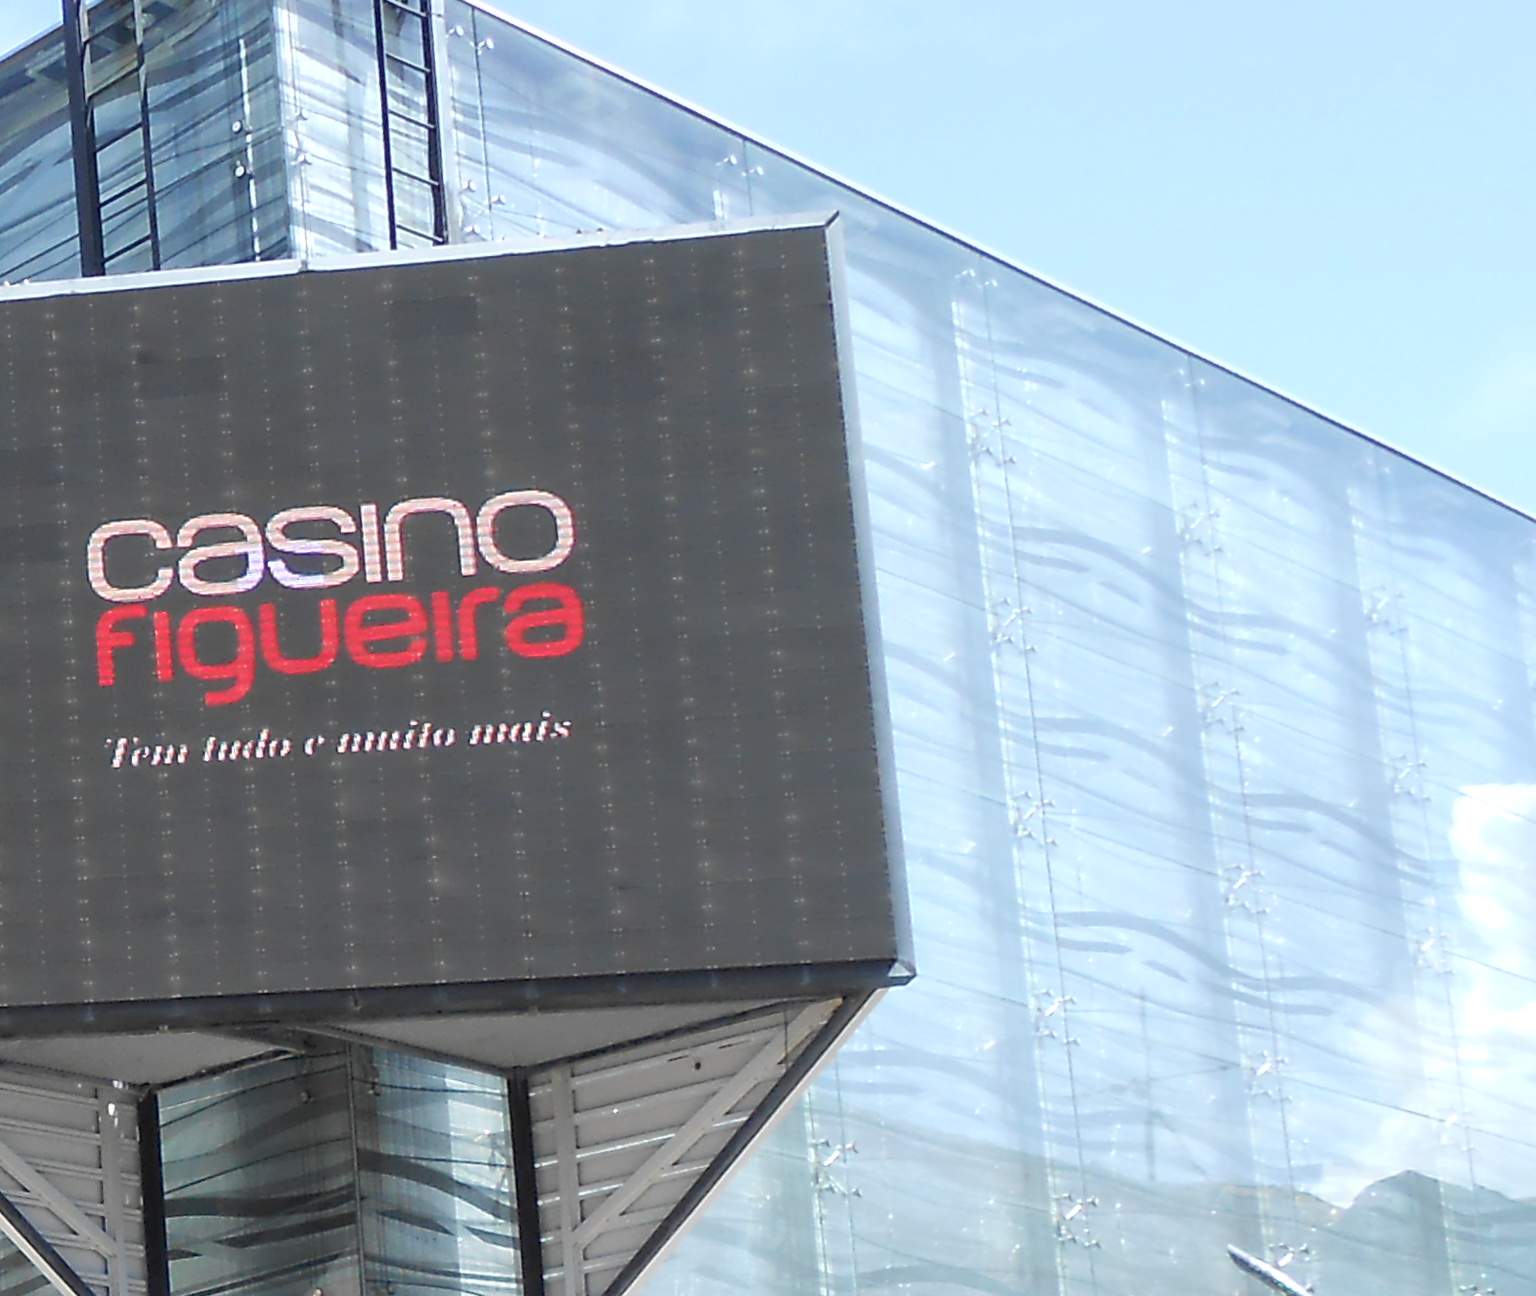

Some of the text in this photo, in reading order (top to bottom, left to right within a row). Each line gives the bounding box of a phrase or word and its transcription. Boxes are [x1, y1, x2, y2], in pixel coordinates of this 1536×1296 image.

[86, 488, 575, 604] casino
[94, 581, 586, 706] figueira
[106, 710, 573, 769] Tem tudo e muito mais
